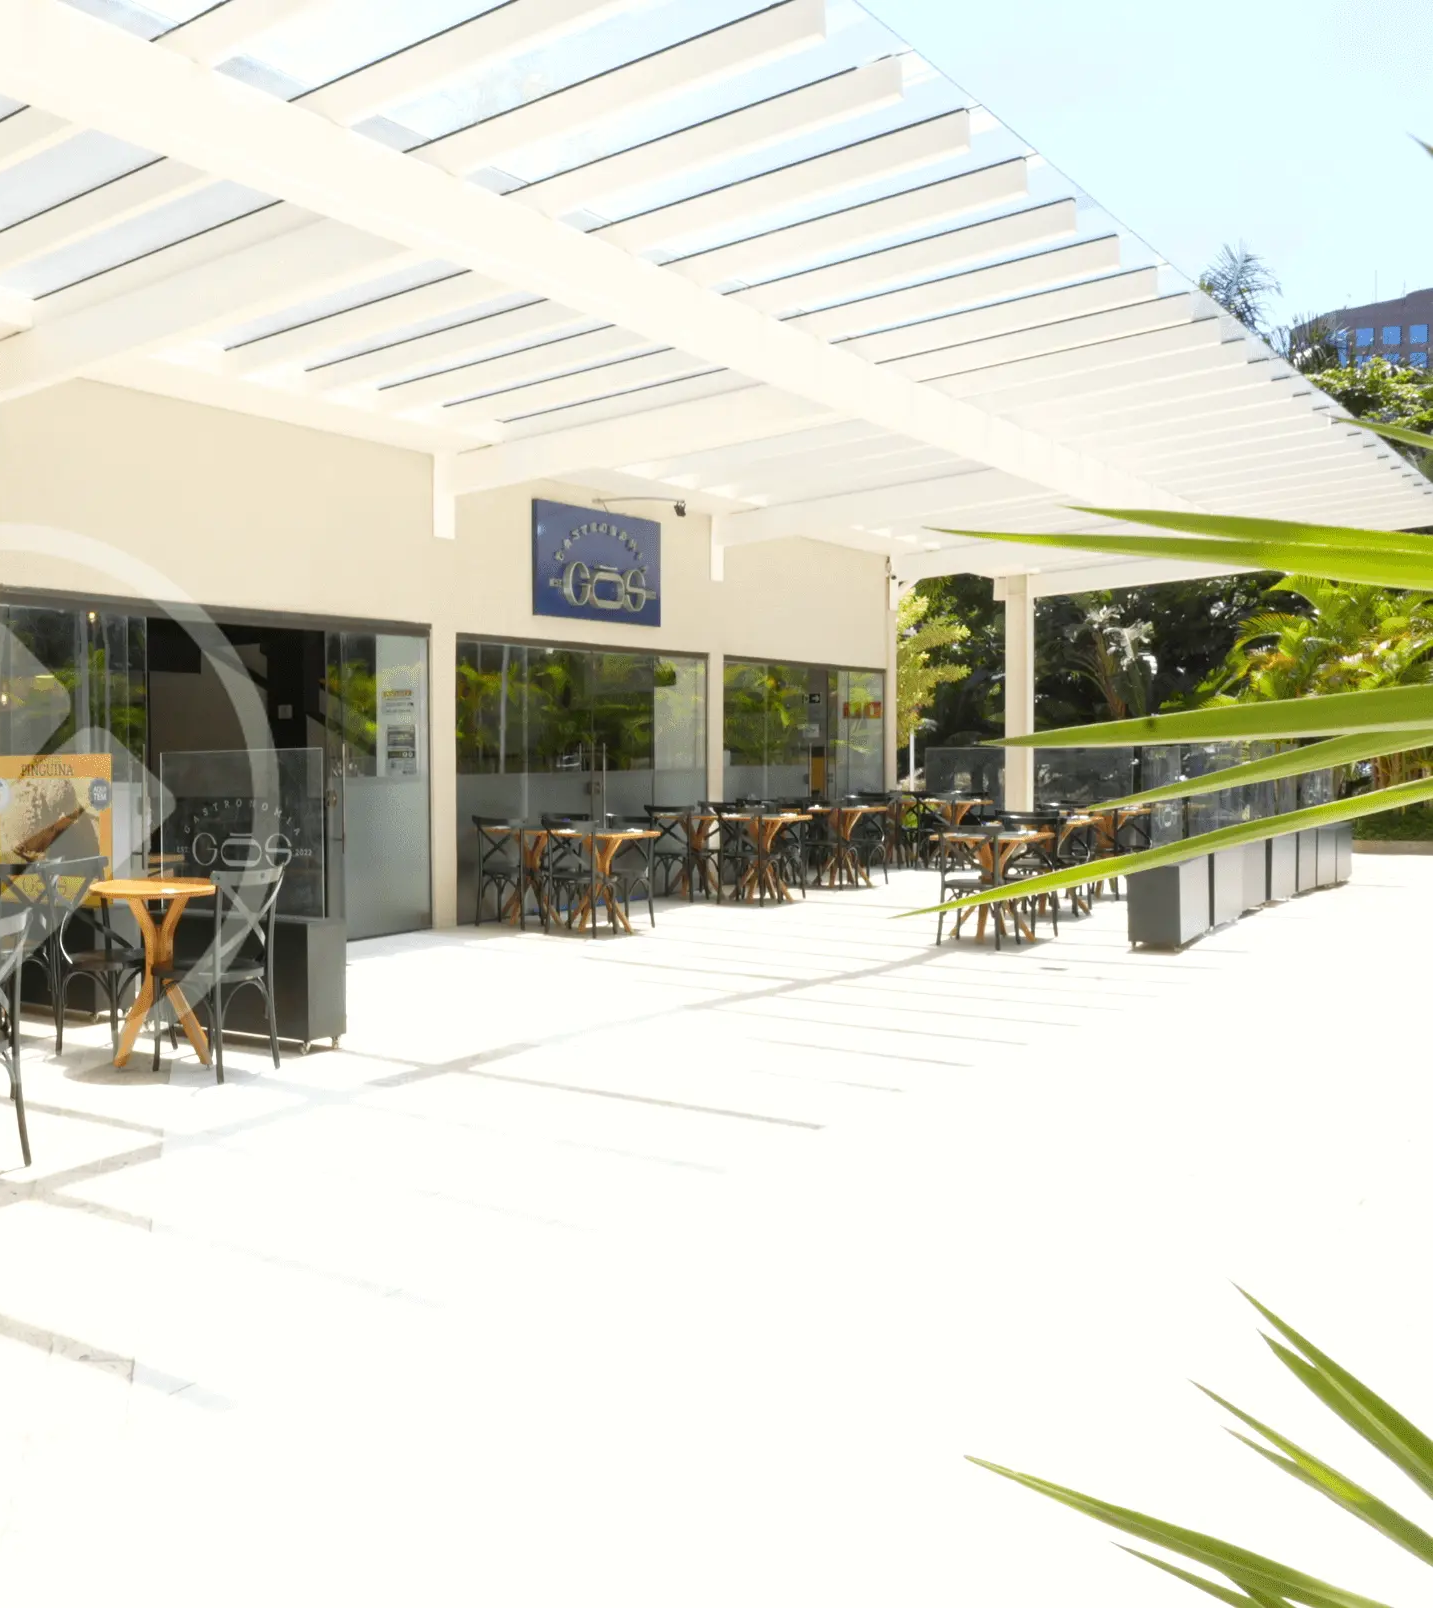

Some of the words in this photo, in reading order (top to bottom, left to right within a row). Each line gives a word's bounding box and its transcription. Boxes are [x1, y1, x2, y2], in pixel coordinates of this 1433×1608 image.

[93, 785, 108, 793] AQUI
[93, 793, 107, 801] TEM
[183, 798, 301, 836] GASTRONOMIA
[293, 848, 313, 857] 2022
